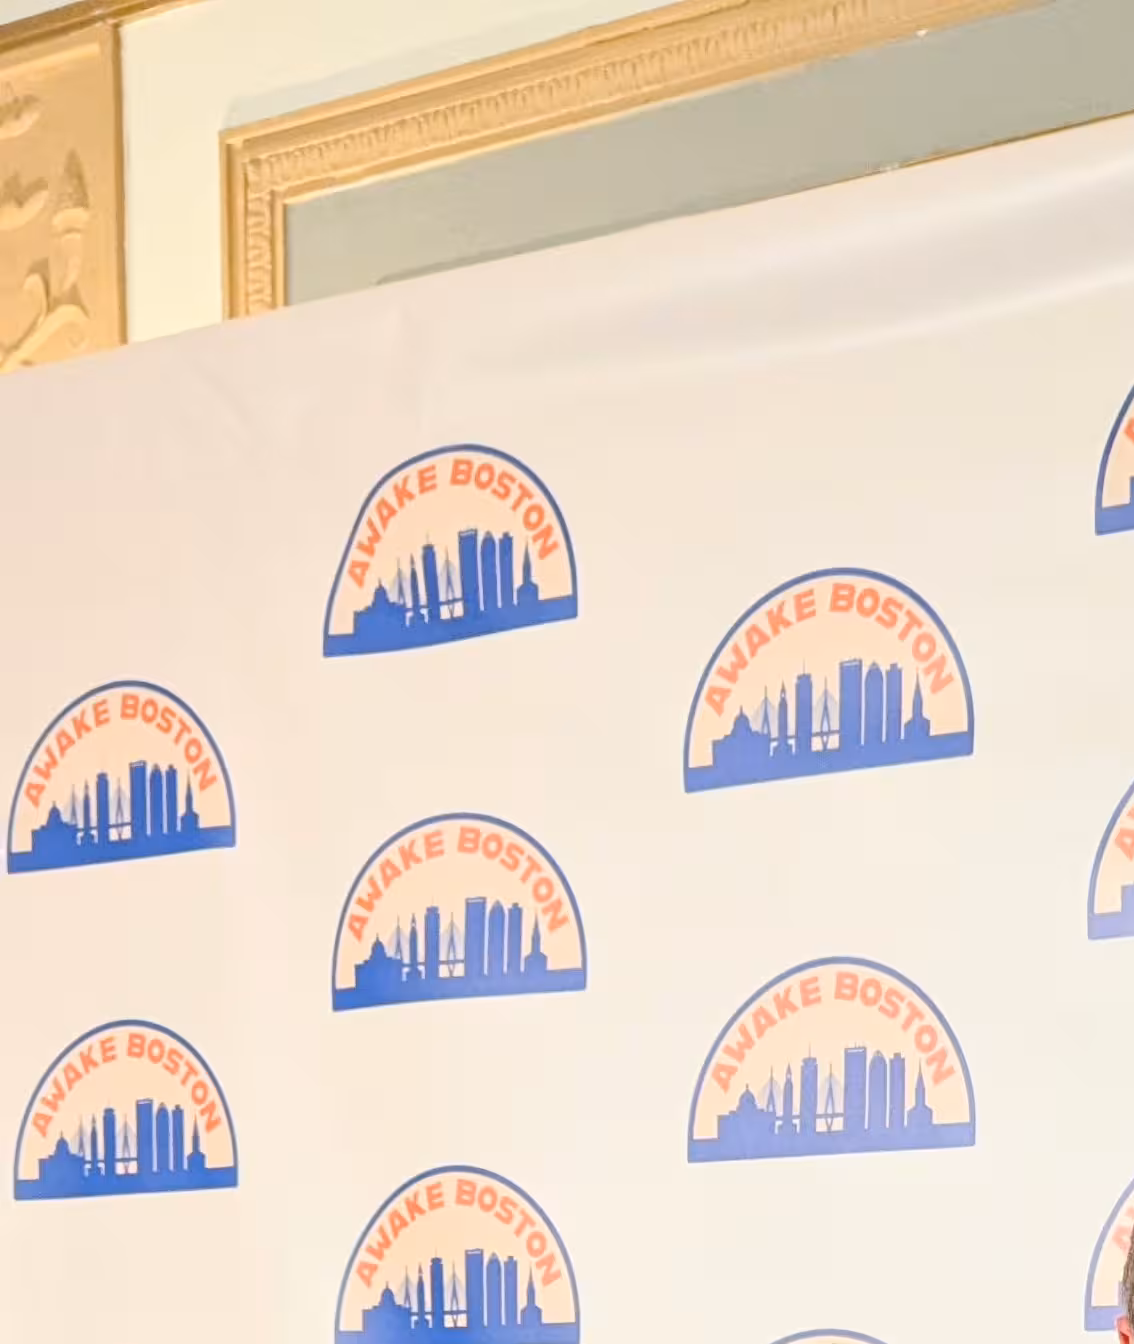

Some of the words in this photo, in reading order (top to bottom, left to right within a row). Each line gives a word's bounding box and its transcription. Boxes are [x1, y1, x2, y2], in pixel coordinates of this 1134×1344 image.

[348, 464, 438, 589] AWAKE
[449, 458, 560, 560] BOSTON
[706, 589, 816, 716] AWAKE
[830, 583, 953, 694] BOSTON
[24, 699, 111, 809] AWAKE
[120, 693, 217, 792] BOSTON
[348, 831, 444, 942] AWAKE
[457, 826, 569, 932] BOSTON
[33, 1036, 117, 1137] AWAKE
[126, 1033, 221, 1133] BOSTON
[712, 977, 821, 1092] AWAKE
[835, 972, 954, 1084] BOSTON
[356, 1183, 445, 1288] AWAKE
[455, 1179, 560, 1286] BOSTON
